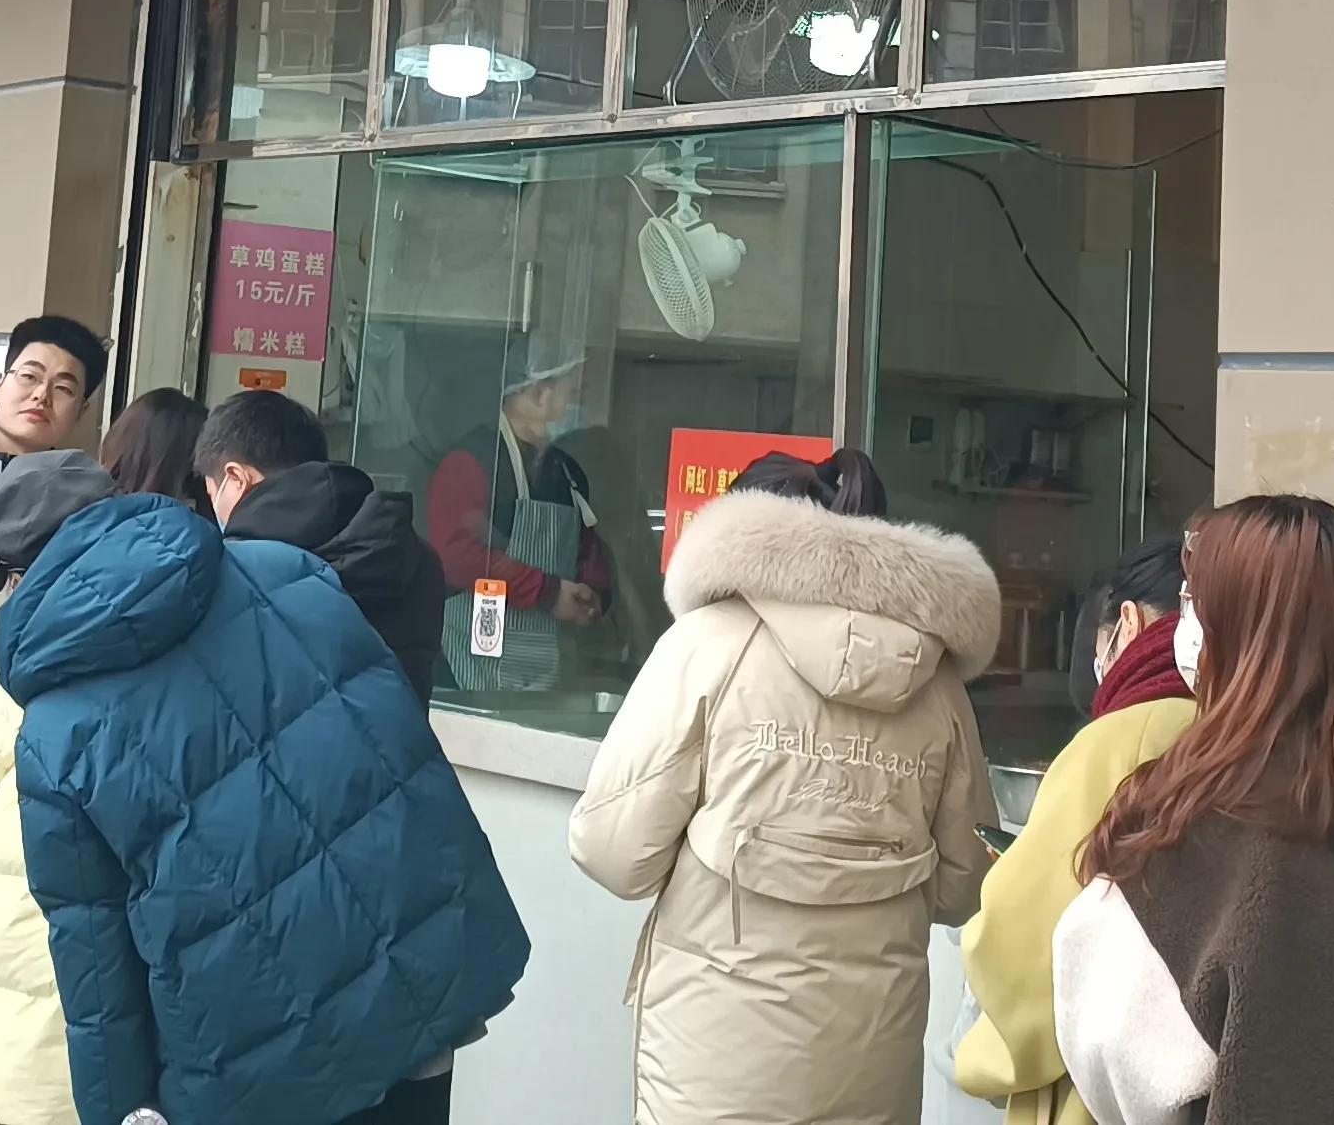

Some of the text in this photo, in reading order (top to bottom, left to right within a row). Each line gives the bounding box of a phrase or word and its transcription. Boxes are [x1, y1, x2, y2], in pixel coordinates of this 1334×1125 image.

[229, 244, 325, 276] 草鸡蛋糕
[235, 279, 316, 307] 15元/斤
[232, 326, 306, 356] 糯米糕
